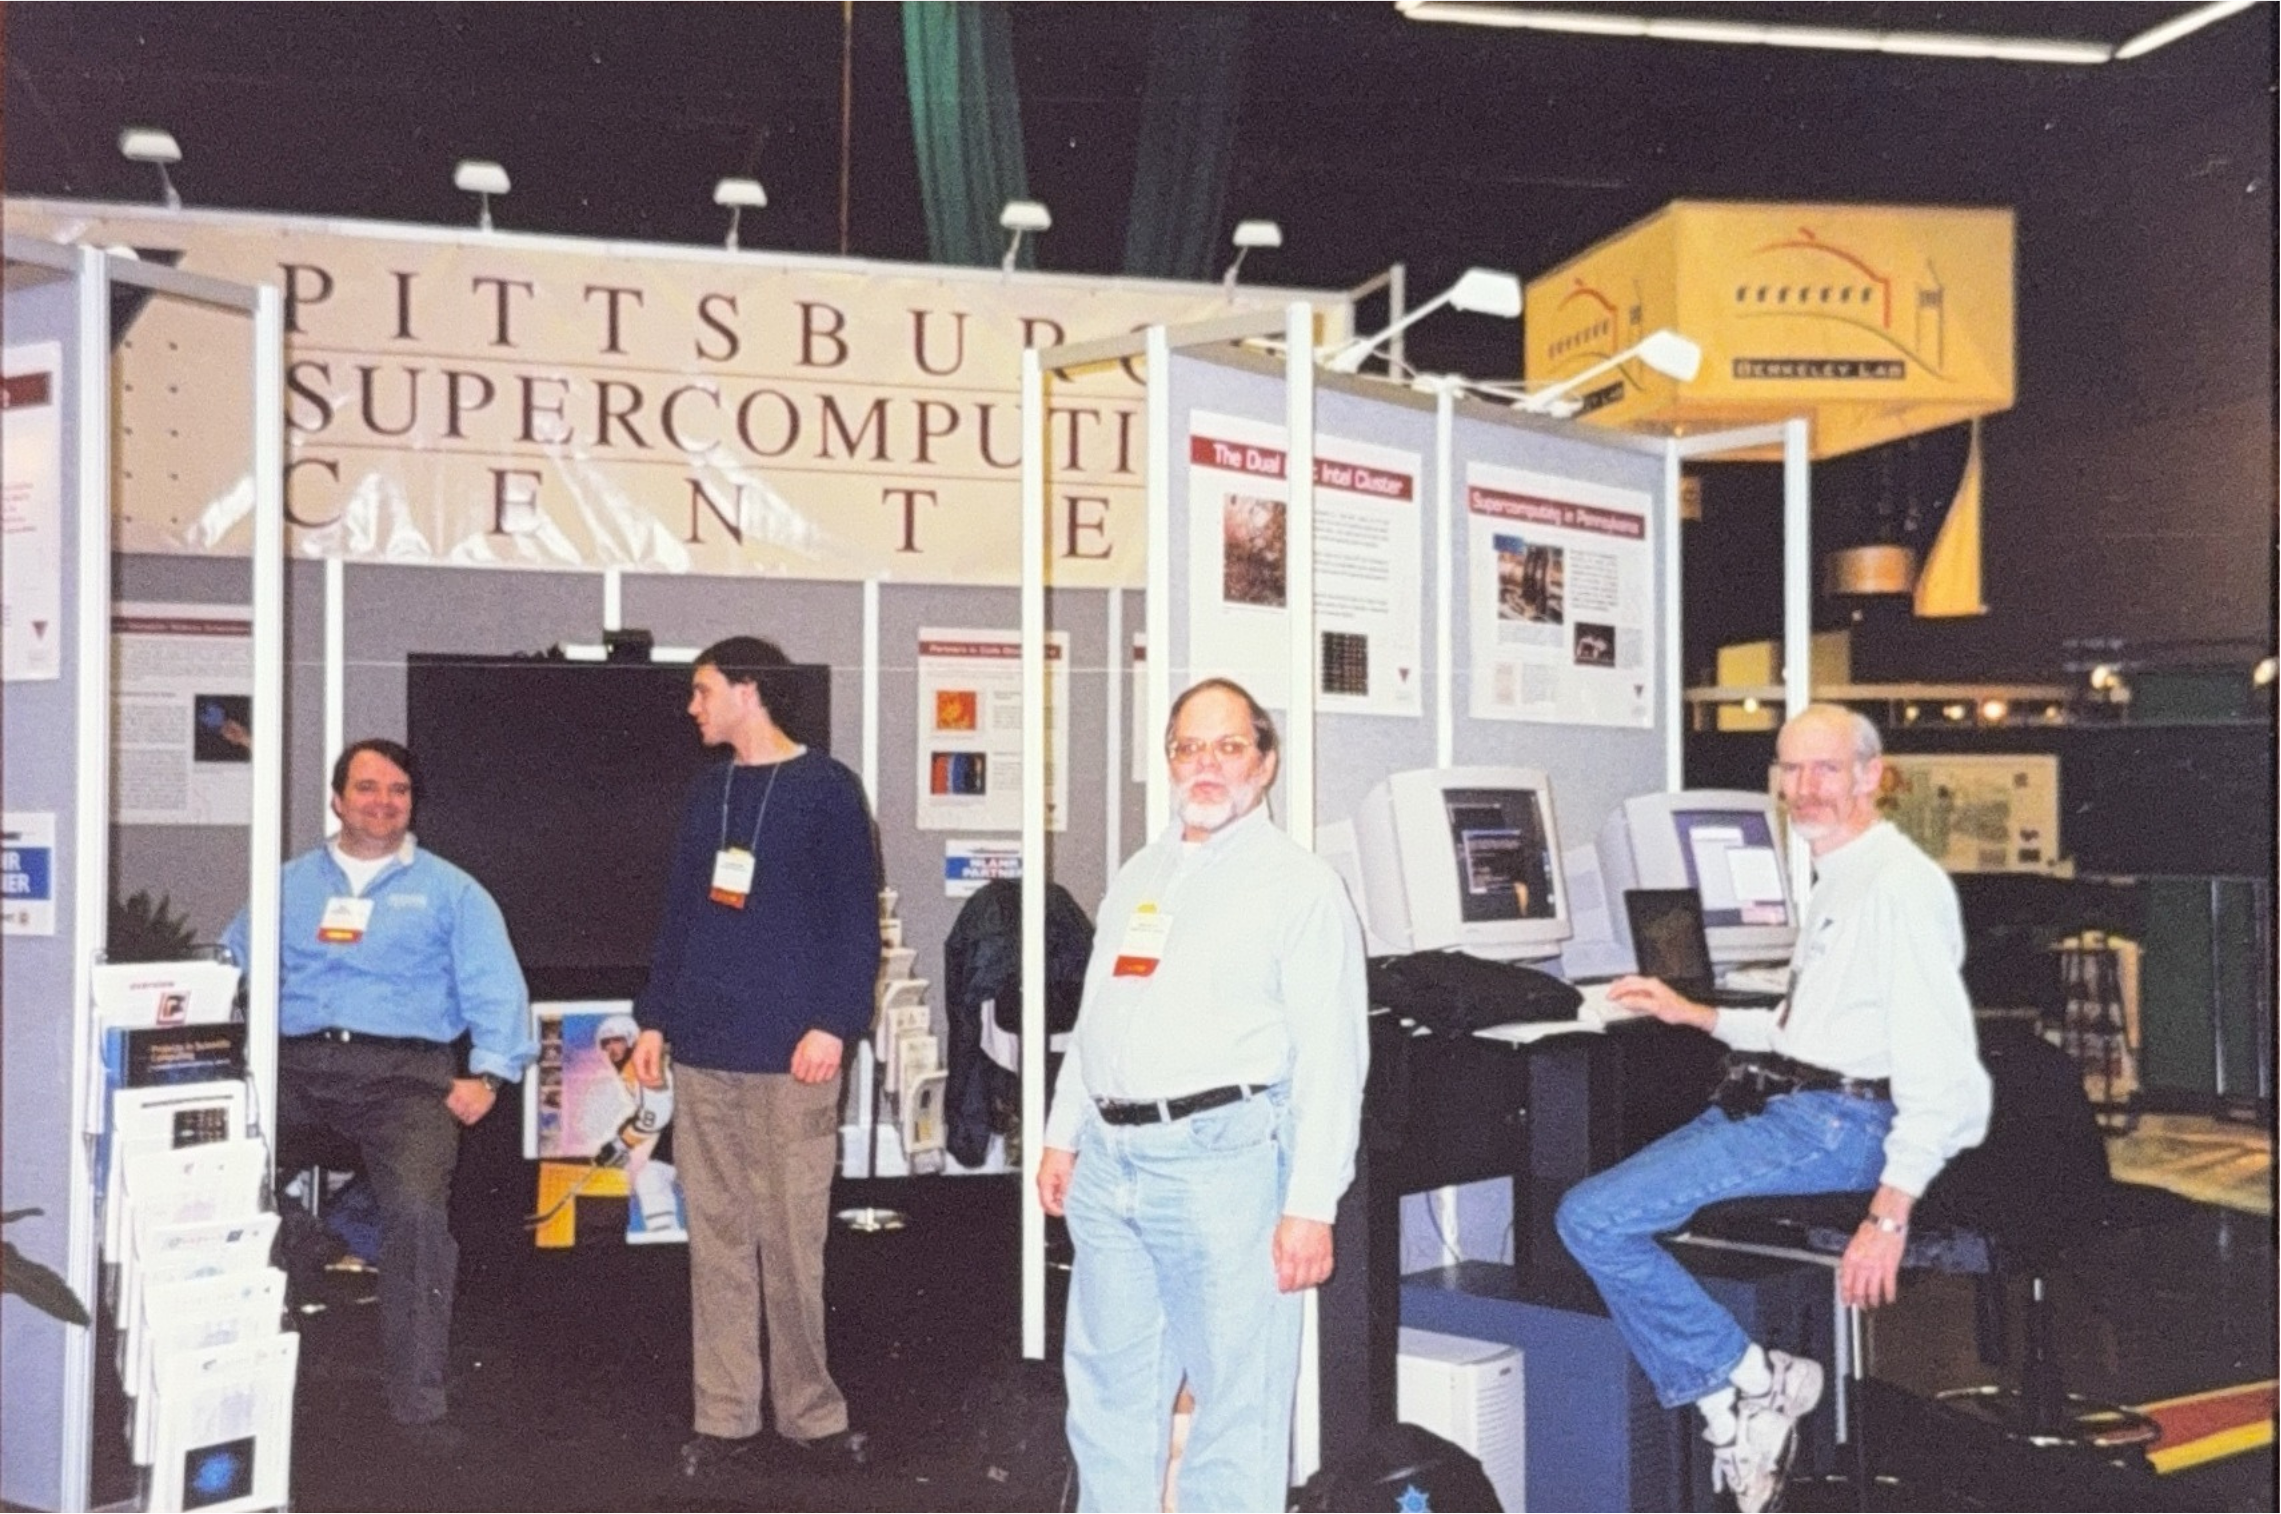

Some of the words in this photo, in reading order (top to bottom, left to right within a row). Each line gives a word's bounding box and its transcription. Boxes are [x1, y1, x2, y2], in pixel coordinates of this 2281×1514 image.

[1212, 443, 1242, 469] The
[1246, 449, 1281, 474] Dual
[1321, 463, 1352, 487] Intel
[1354, 470, 1404, 496] Cluster
